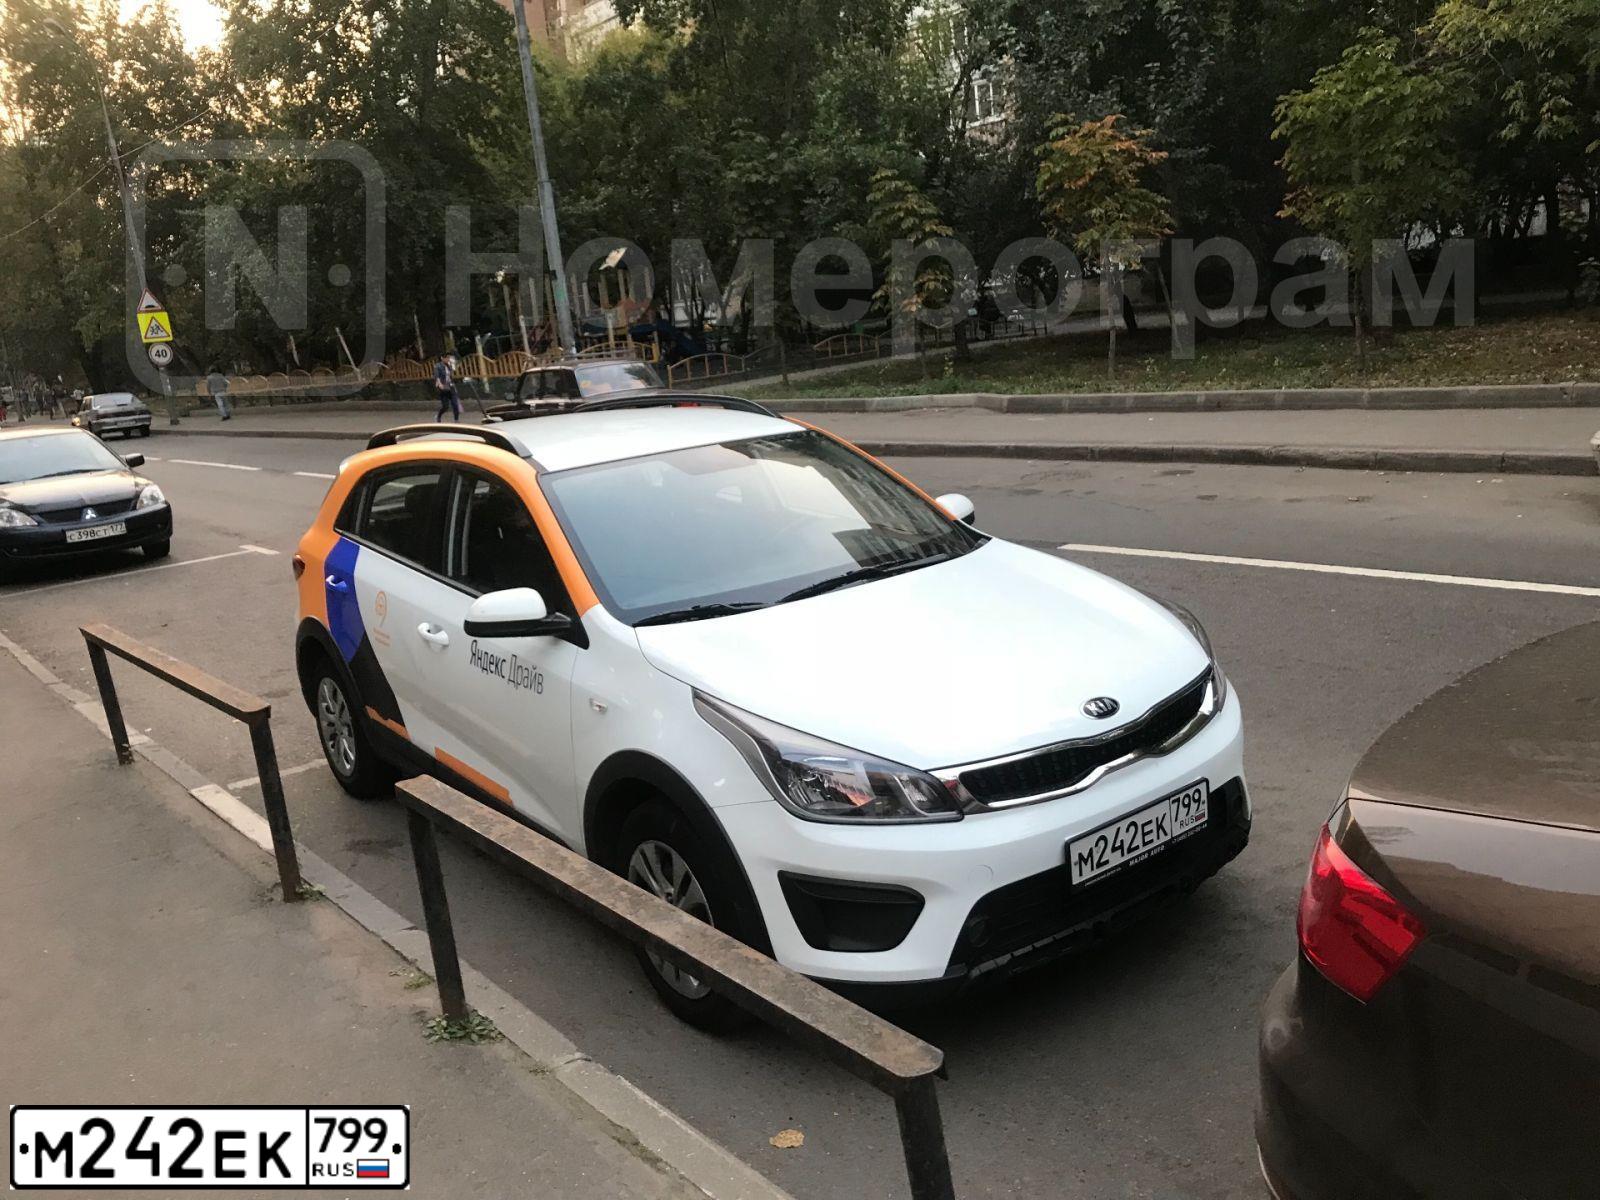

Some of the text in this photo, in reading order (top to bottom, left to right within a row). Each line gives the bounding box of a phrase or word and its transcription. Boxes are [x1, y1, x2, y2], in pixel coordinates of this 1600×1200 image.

[154, 348, 168, 358] 40
[469, 639, 545, 695] Яндекс Драйв
[1171, 788, 1201, 823] 799
[1179, 816, 1196, 830] RUS
